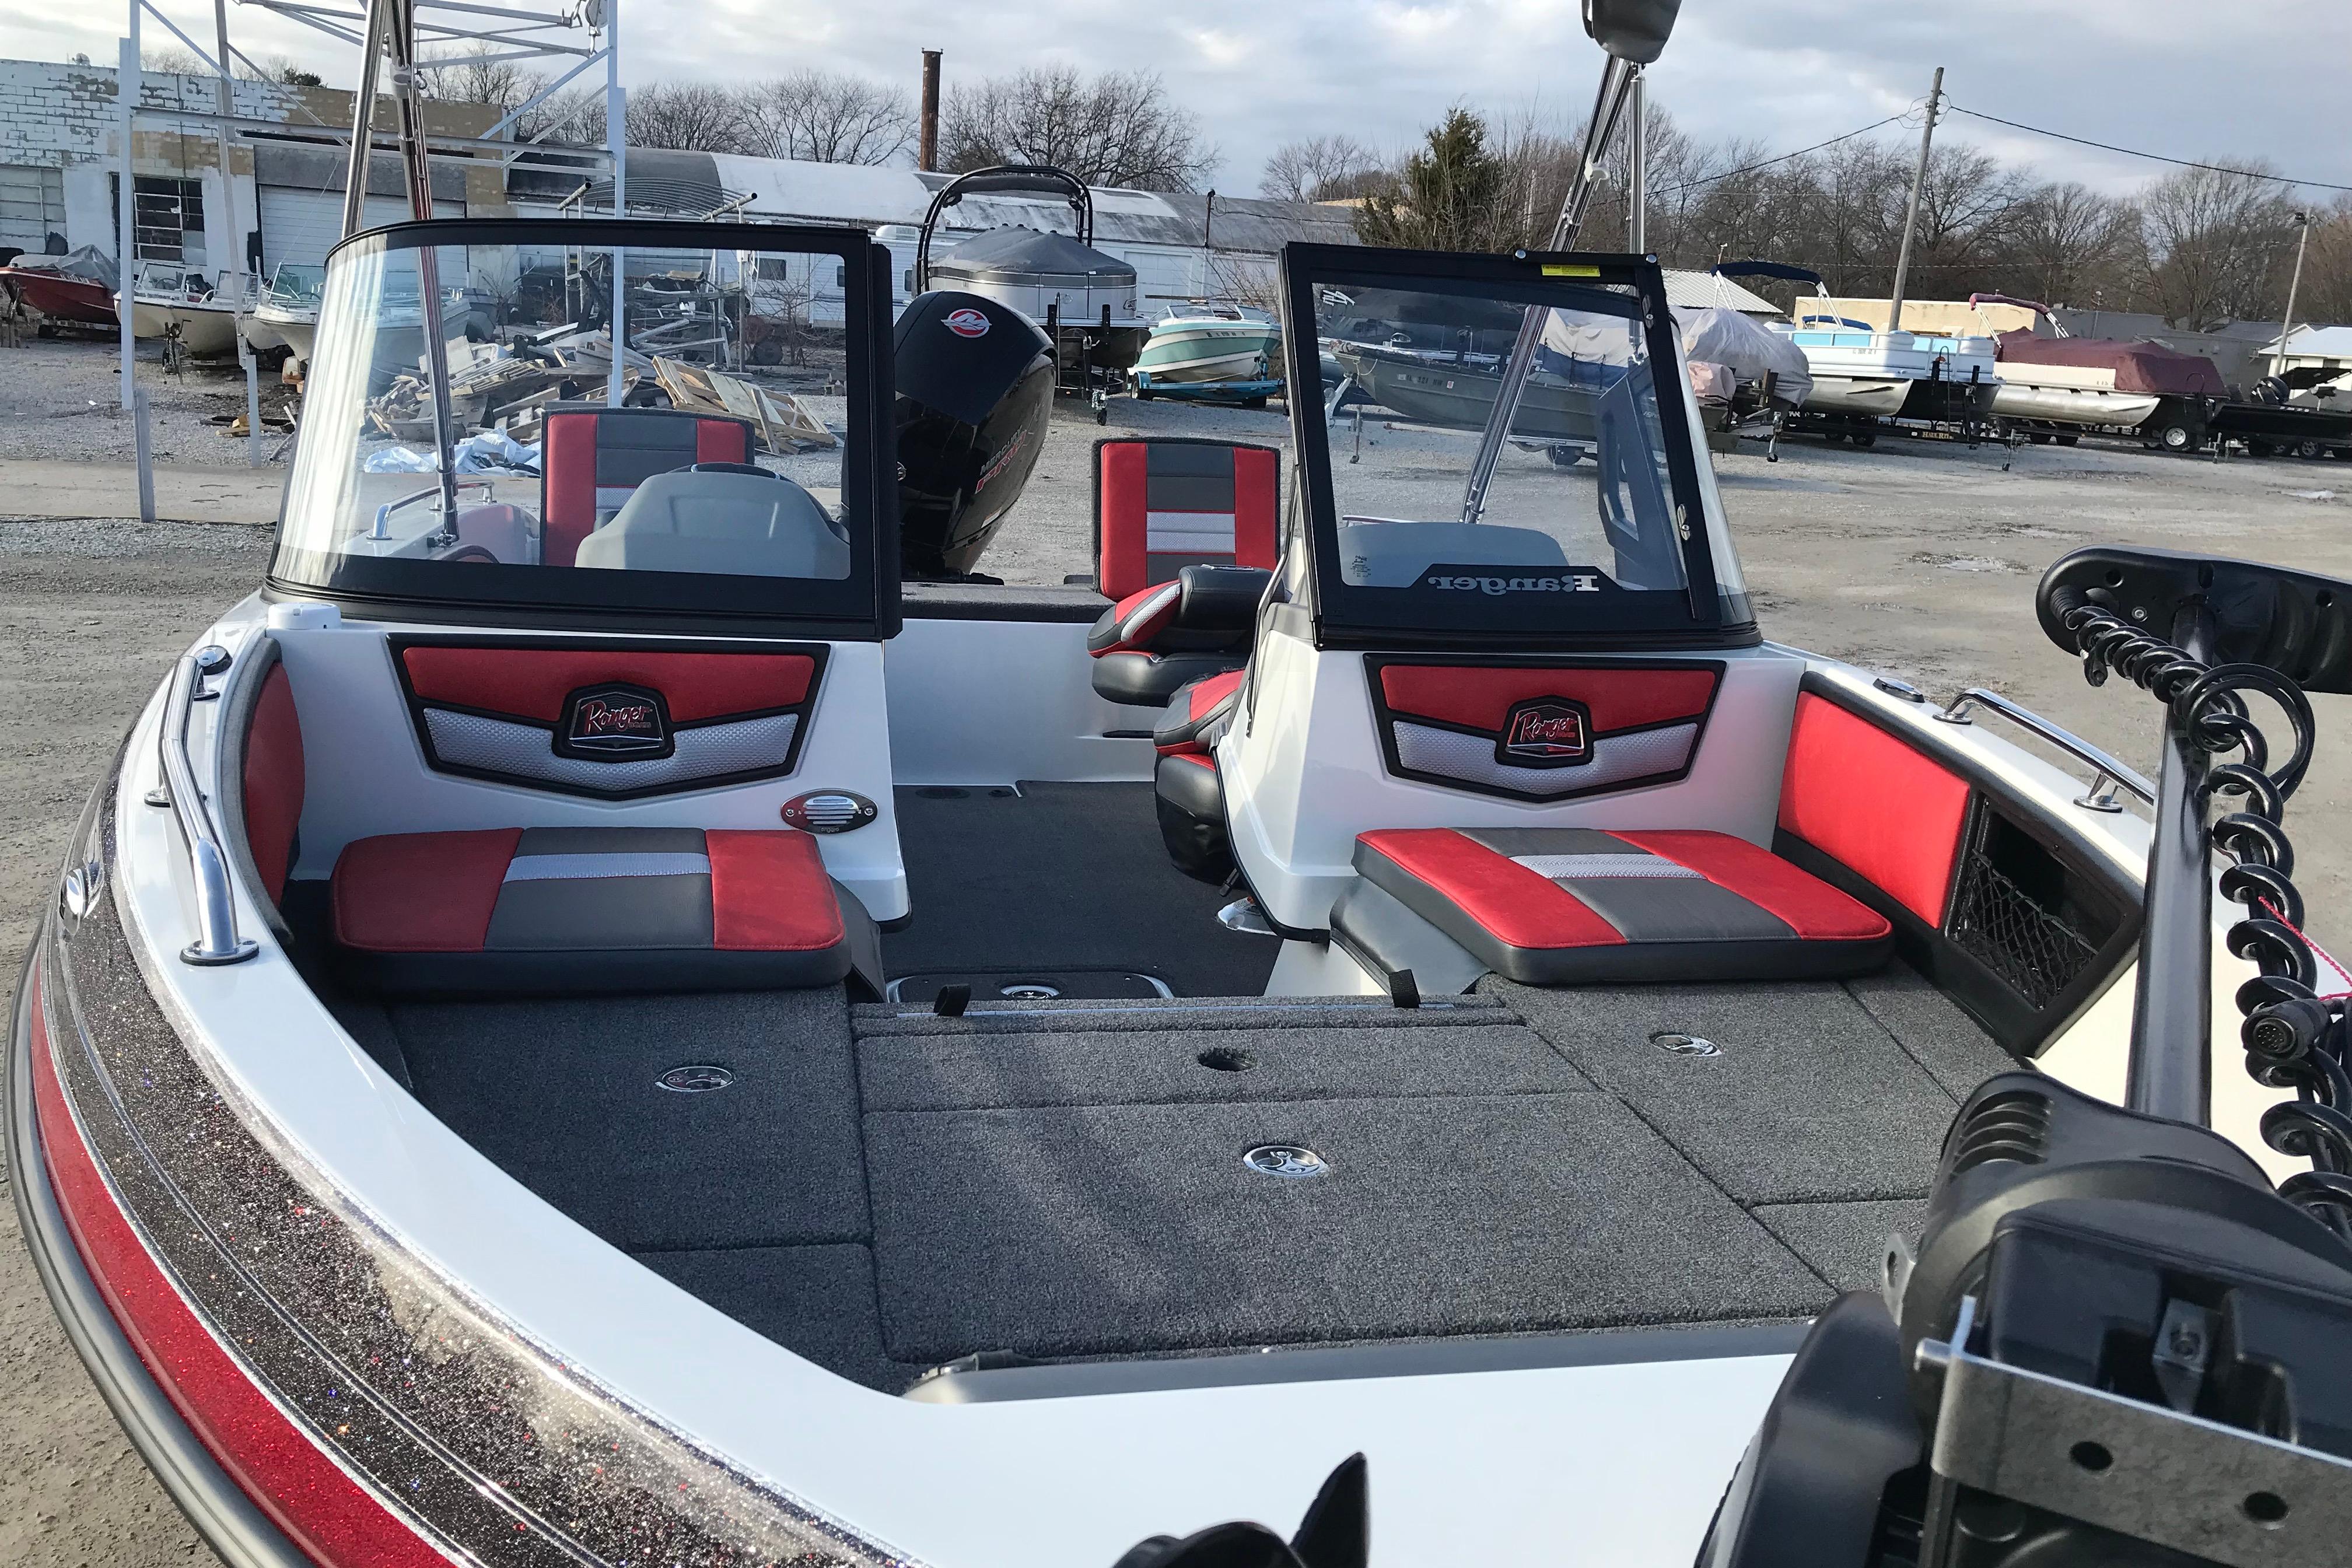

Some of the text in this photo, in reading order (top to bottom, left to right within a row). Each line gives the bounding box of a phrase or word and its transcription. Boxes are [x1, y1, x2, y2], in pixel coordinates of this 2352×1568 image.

[980, 425, 1022, 475] MERCURY
[581, 700, 653, 735] Ranger
[1519, 712, 1577, 742] Ranger
